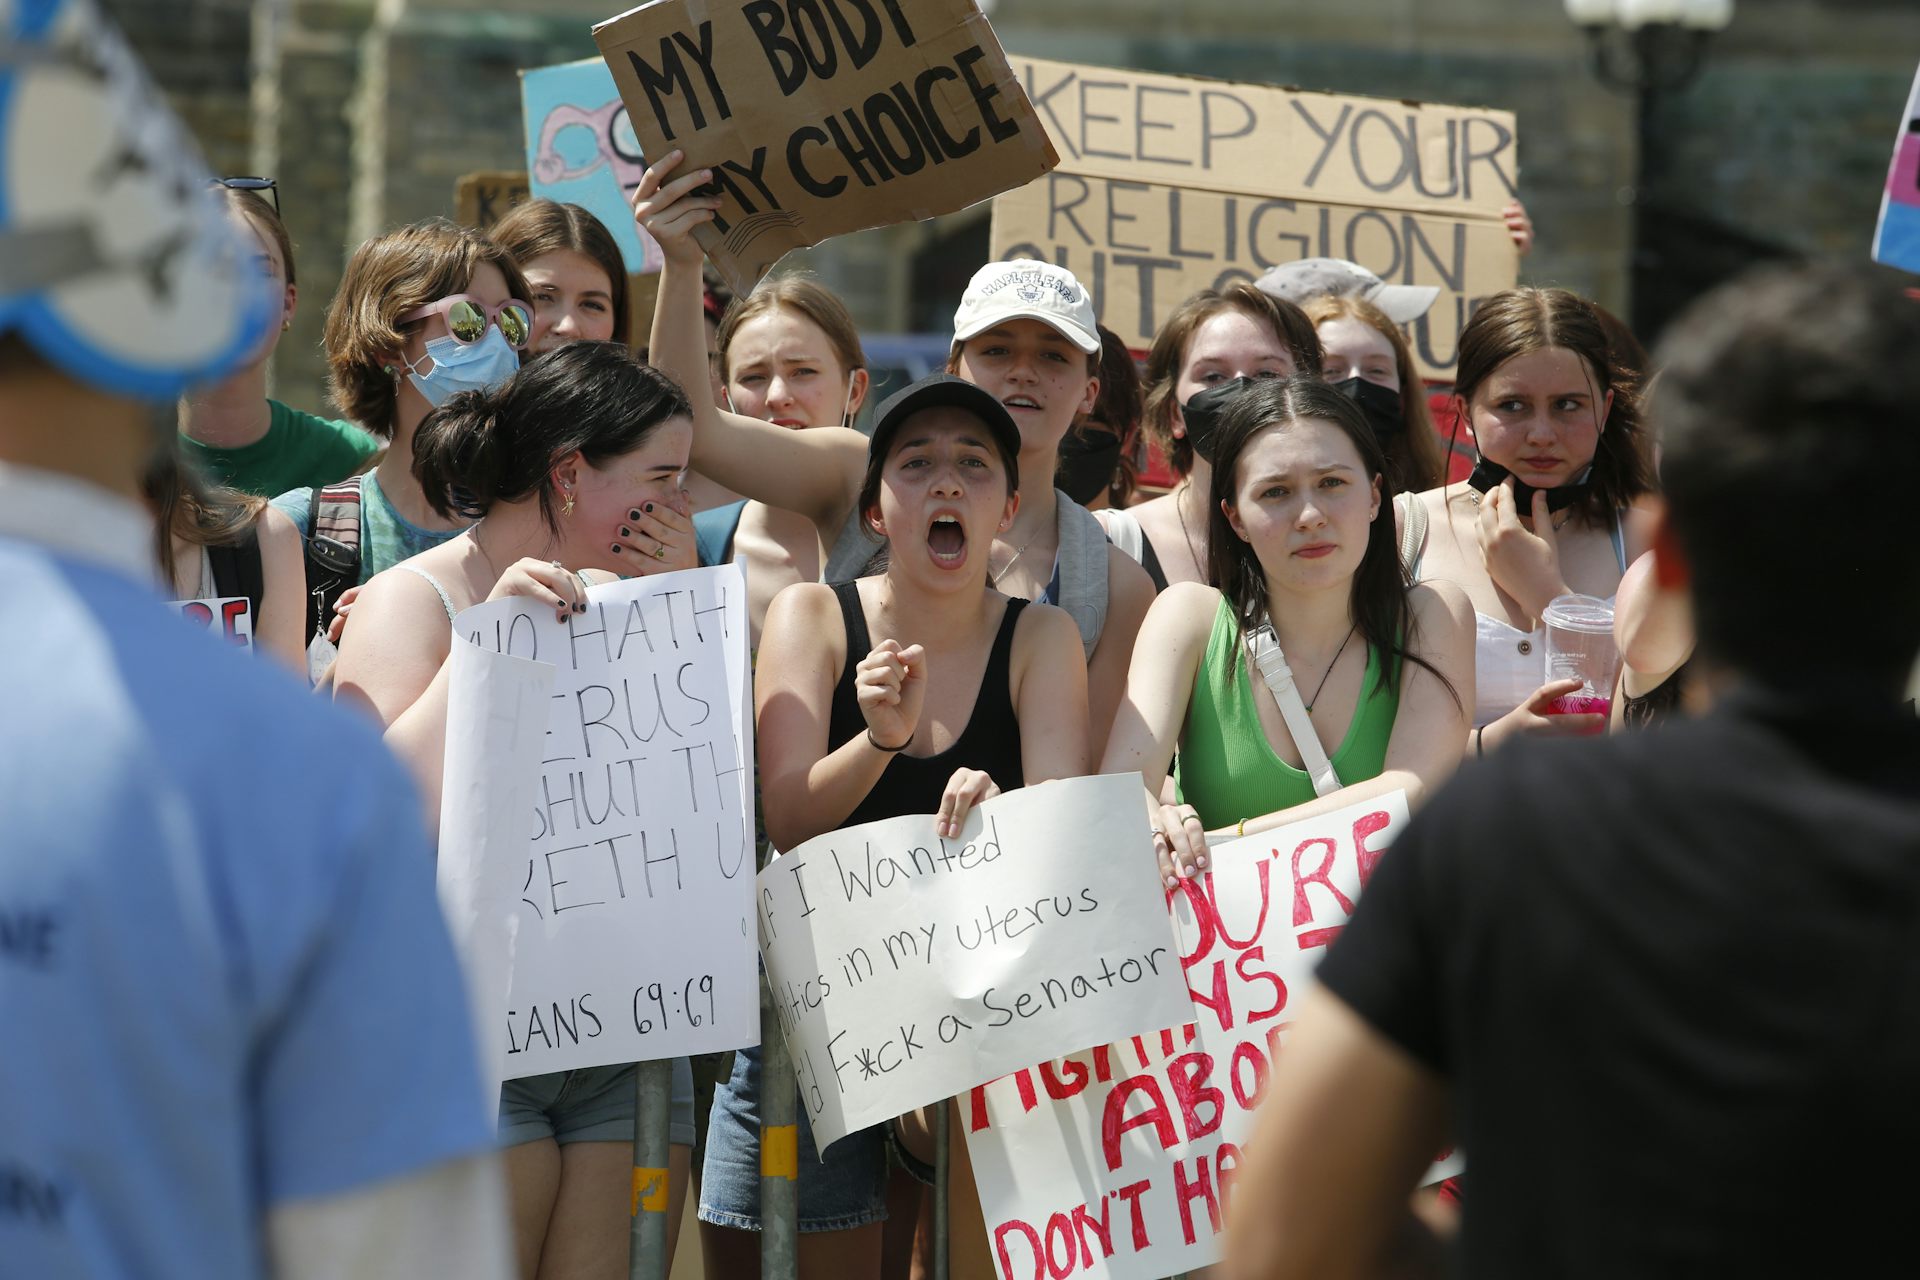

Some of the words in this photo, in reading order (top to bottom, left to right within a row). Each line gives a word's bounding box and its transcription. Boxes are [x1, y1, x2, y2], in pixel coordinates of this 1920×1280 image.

[626, 21, 732, 141] MY
[688, 147, 783, 236] MY
[786, 45, 1020, 198] CHOICE
[1025, 65, 1257, 170] KEEP
[1290, 99, 1516, 200] YOUR
[1048, 172, 1467, 292] RELIGION
[982, 271, 1033, 297] MAPLE
[1033, 271, 1076, 304] LEAFS
[1000, 243, 1182, 339] UT
[569, 587, 729, 669] HATH
[790, 863, 816, 918] I
[831, 815, 1001, 902] Wanted
[838, 946, 873, 987] in
[882, 922, 936, 969] my
[956, 888, 1099, 950] uterus
[632, 974, 714, 1035] 69:69
[938, 1015, 972, 1043] a
[983, 947, 1167, 1027] Senator
